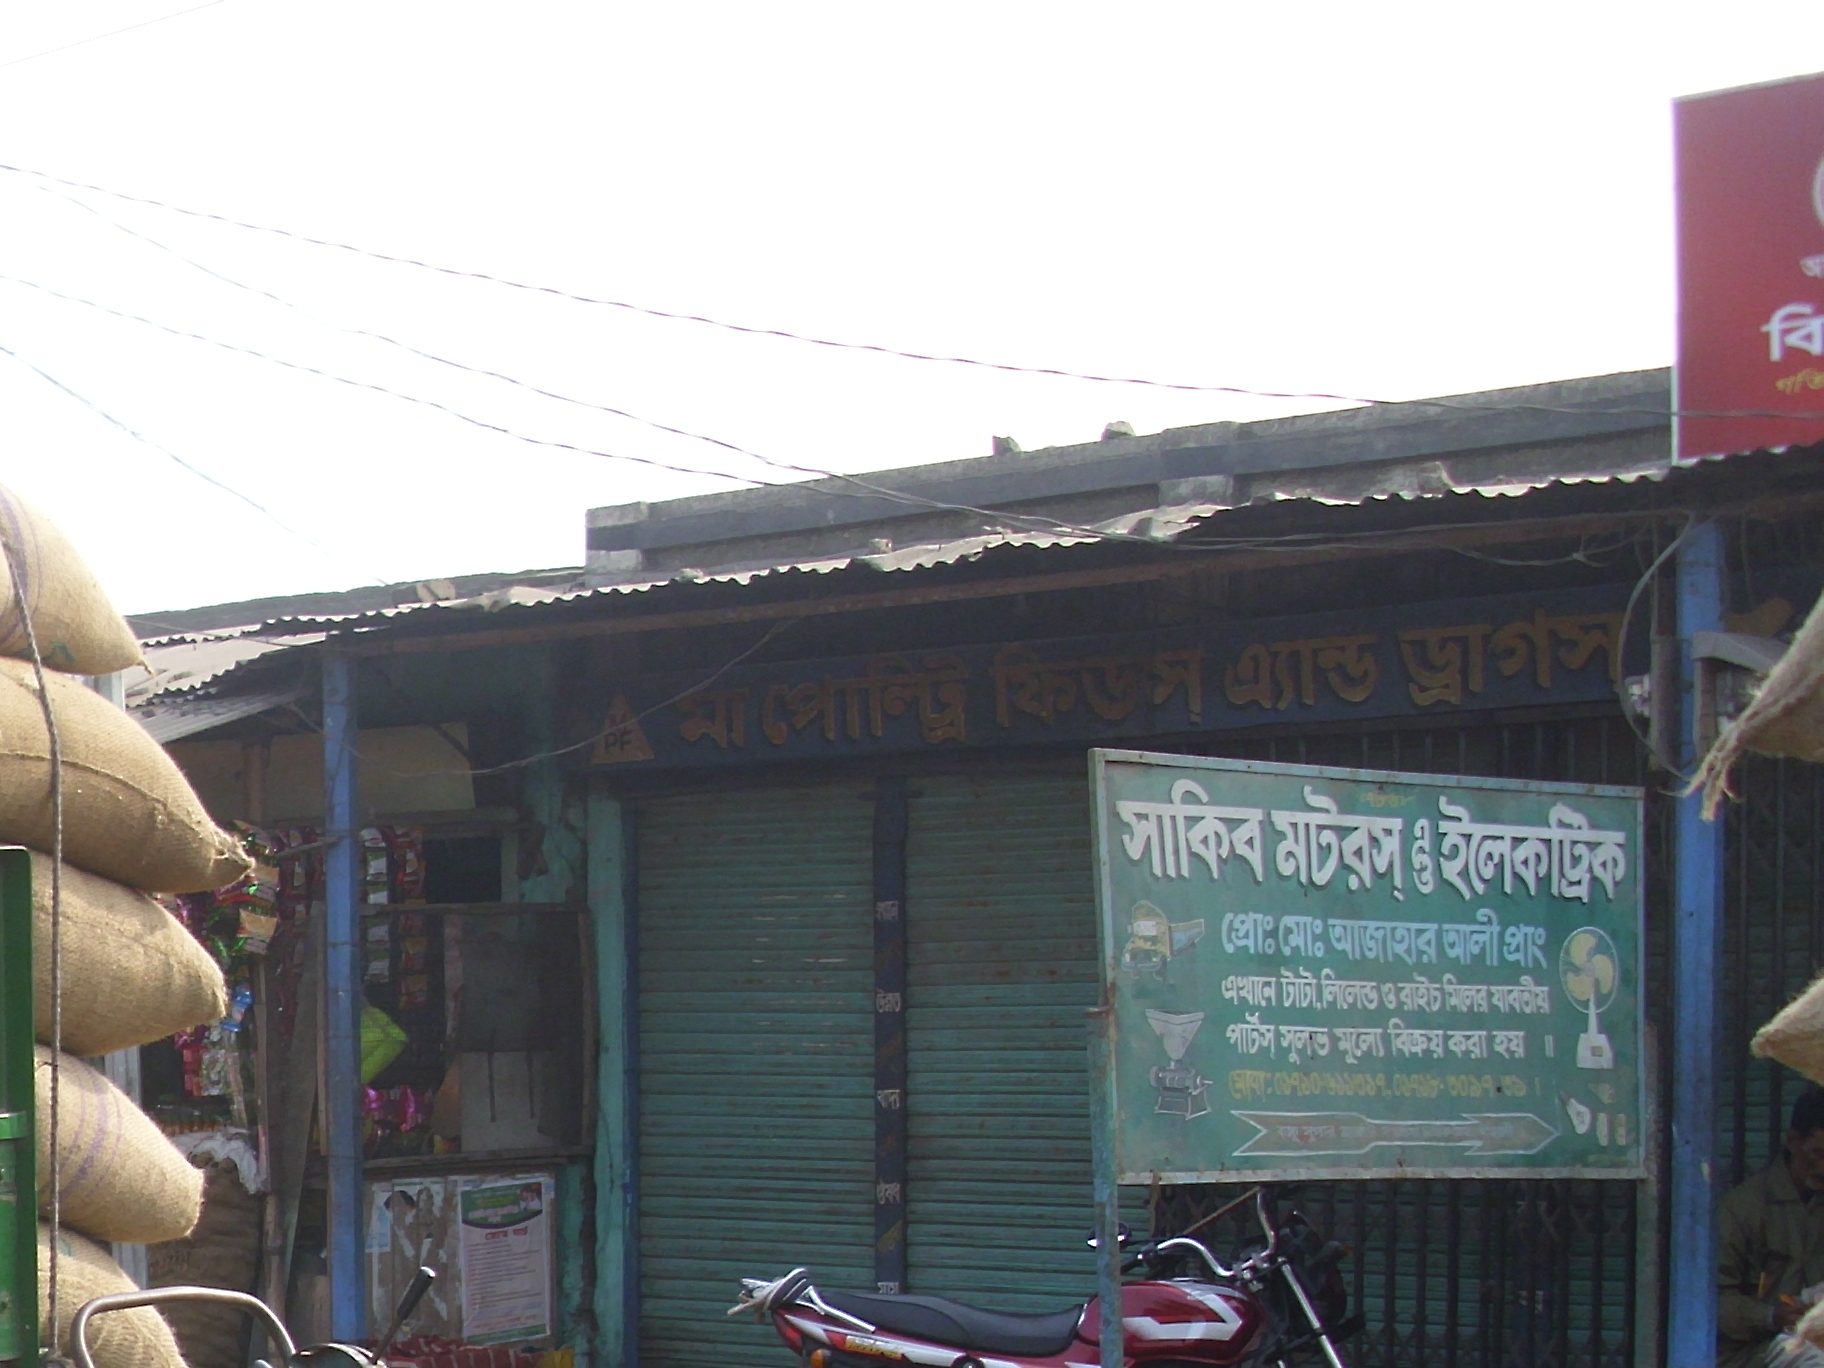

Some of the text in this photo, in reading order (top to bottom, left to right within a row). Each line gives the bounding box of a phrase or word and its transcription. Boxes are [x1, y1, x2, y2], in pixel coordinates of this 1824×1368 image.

[676, 688, 750, 750] মা
[761, 653, 969, 745] পোল্ট্রি
[1116, 778, 1264, 883] সাকিব
[1272, 785, 1404, 900] মটরস্
[1438, 795, 1626, 904] ইলেকট্রিক
[1279, 914, 1325, 958] মোঃ
[1327, 918, 1438, 965] আজাহার
[1442, 908, 1501, 967] আলী
[1503, 922, 1547, 970] প্রাং
[1221, 973, 1276, 1007] এখানে
[1380, 982, 1395, 1010] ও
[1397, 972, 1442, 1013] রাইচ
[1443, 973, 1489, 1014] মিলের
[1489, 975, 1551, 1015] যাবতীয়
[1279, 1025, 1329, 1065] সুলভ
[1388, 1017, 1444, 1059] বিক্রয়
[1446, 1030, 1488, 1060] করা
[1492, 1030, 1525, 1060] হয়
